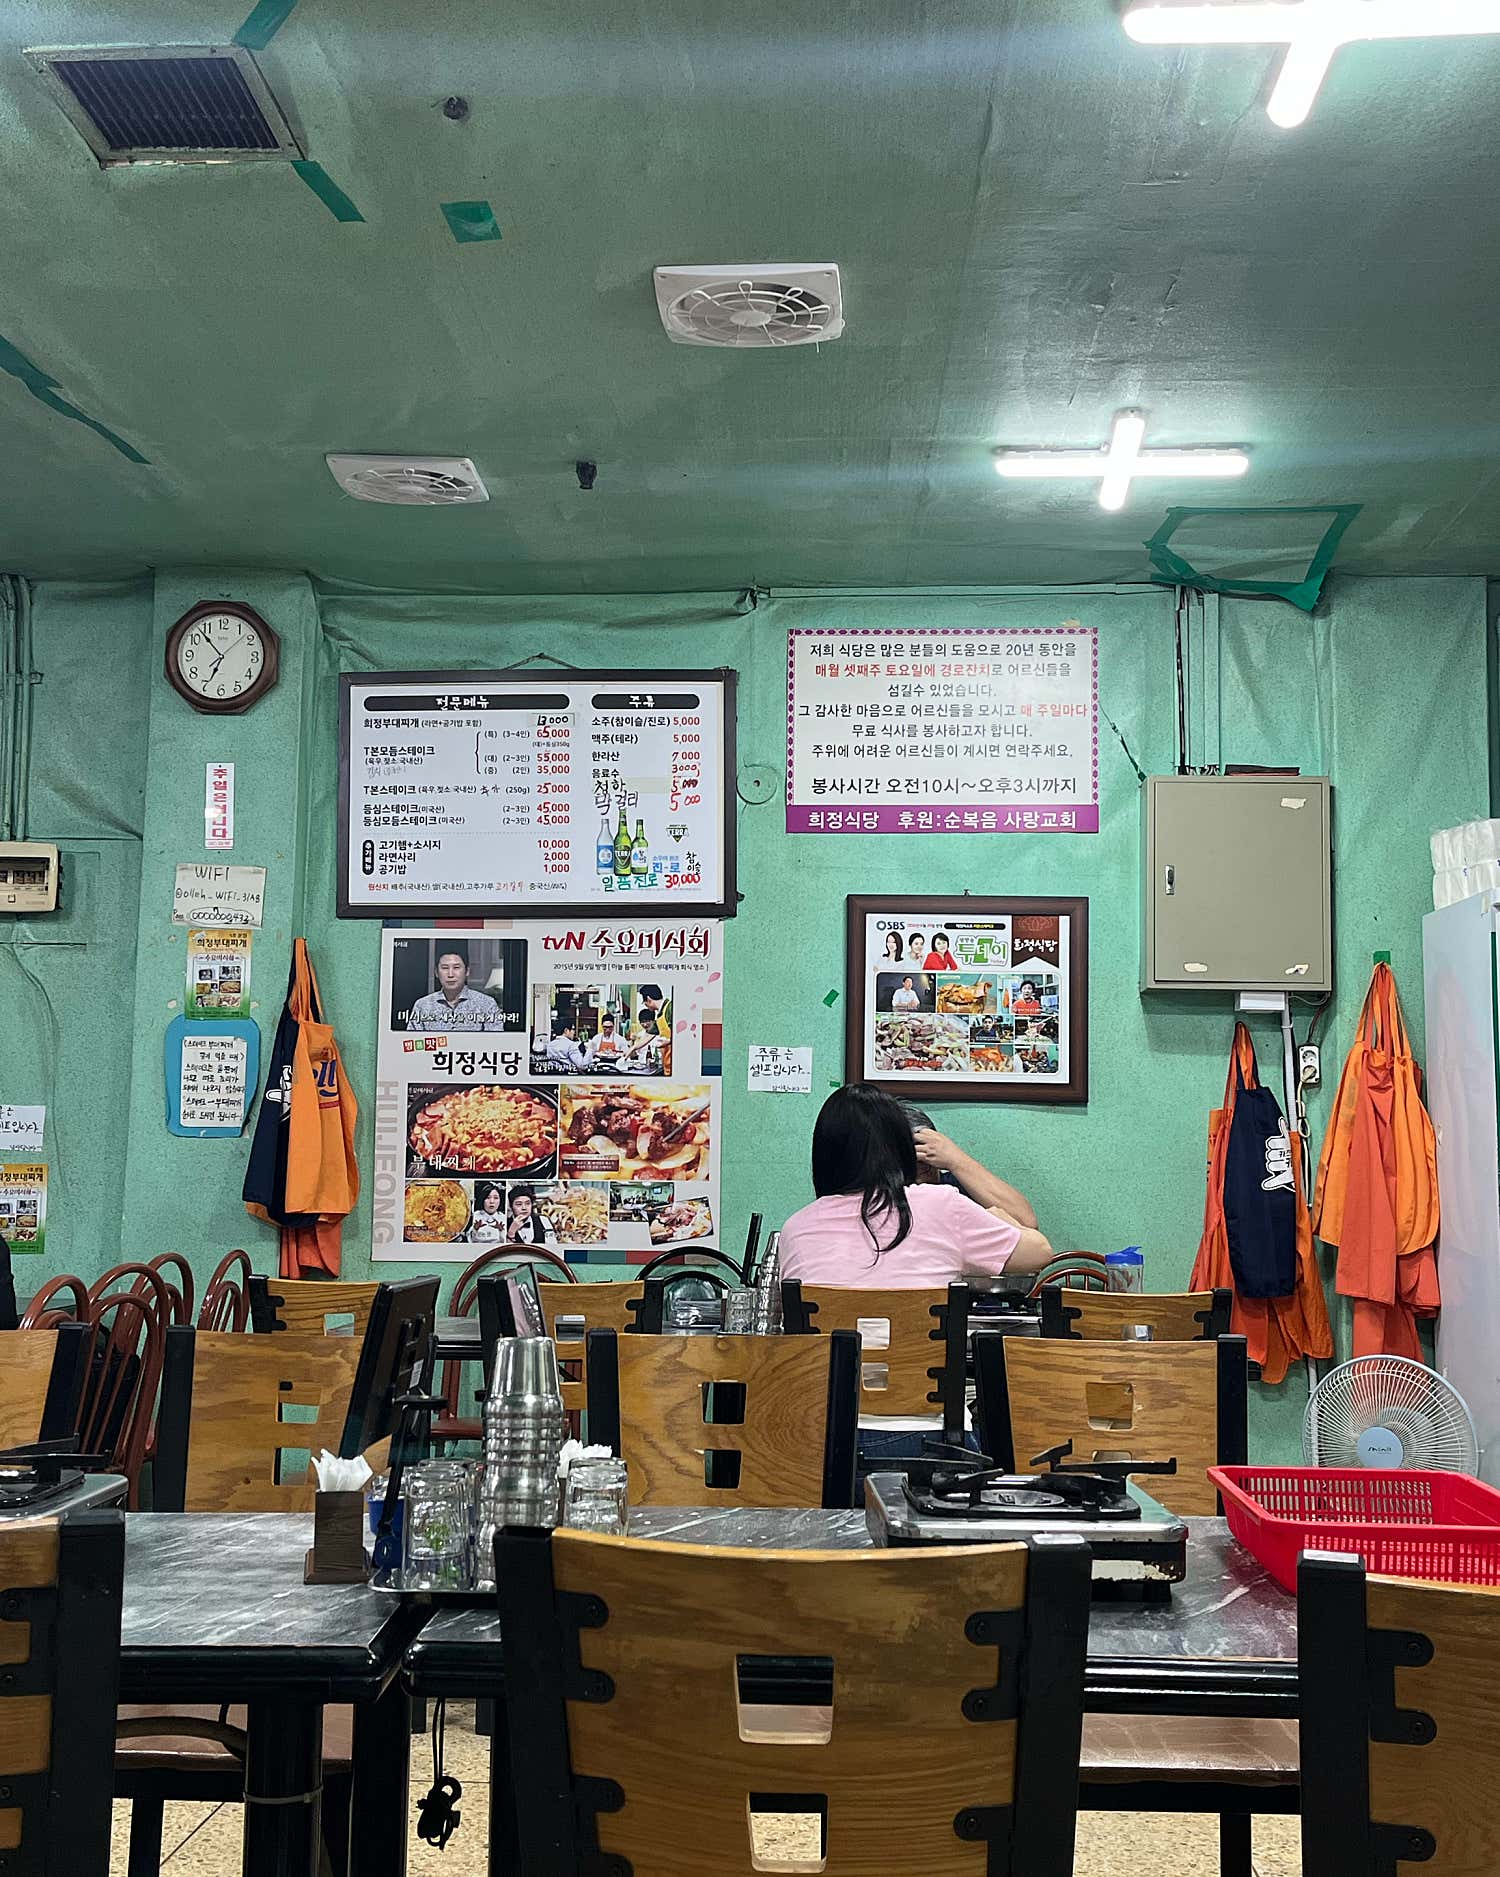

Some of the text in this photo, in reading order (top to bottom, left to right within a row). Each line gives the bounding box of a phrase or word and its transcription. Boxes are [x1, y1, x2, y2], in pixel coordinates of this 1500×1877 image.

[203, 622, 212, 634] 11
[219, 618, 229, 630] 12
[237, 623, 242, 635] 1
[190, 634, 201, 646] 10
[247, 634, 255, 646] 2
[185, 649, 194, 662] 9
[810, 642, 1077, 658] 저희 식당은 많은 분들의 도움으로 20년 동안을
[251, 651, 259, 664] 3
[189, 666, 198, 679] 8
[245, 667, 253, 680] 4
[815, 663, 1072, 678] 매월 셋째주 토요일에 경로잔치로 어르신들을
[202, 680, 211, 692] 7
[217, 684, 226, 697] 6
[233, 681, 242, 693] 5
[887, 683, 998, 698] 섬길수 있었습니다.
[435, 695, 490, 711] 전문메뉴
[629, 695, 656, 708] 주류
[799, 703, 1088, 718] 그 감사한 마음으로 어르신들을 모시고 매 주일마다
[363, 718, 420, 729] 희정부대찌개
[464, 719, 482, 728] 포함)
[591, 716, 700, 727] 소주(참이슬/진로) 5,000
[536, 725, 570, 739] 65,000
[852, 723, 1033, 739] 무료 식사를 봉사하고자 합니다.
[591, 733, 700, 745] 맥주(테라) 5,000
[363, 746, 436, 756] T본모듬스테이크
[591, 751, 621, 762] 한라산
[811, 743, 1074, 759] 주위에 어려운 어르신들이 계시면 연락주세요.
[399, 757, 423, 765] 국내산)
[484, 752, 570, 764] (대) (2~3인) 55,000
[512, 766, 530, 775] (2인)
[536, 765, 570, 776] 35,000
[591, 767, 620, 779] 음료수
[363, 785, 417, 796] T본스테이크
[453, 785, 477, 794] 국내산)
[505, 786, 530, 795] (250g)
[811, 776, 1077, 795] 봉사시간 오전10시~오후3시까지
[502, 805, 530, 814] (2~3인)
[536, 801, 570, 814] 45,000
[594, 790, 639, 815] 막걸리
[502, 817, 530, 826] (2~3인)
[536, 814, 570, 826] 45,000
[808, 811, 880, 830] 희정식당
[1003, 810, 1077, 829] 사랑교회
[378, 839, 570, 851] 고기햄+소시지 10,000
[378, 851, 570, 863] 라면사리 2,000
[194, 865, 230, 881] WIFI
[378, 863, 570, 876] 공기밥 1,000
[664, 872, 701, 889] 30,000
[887, 920, 905, 930] SBS
[542, 925, 711, 958] tvN 수요미식회
[1013, 937, 1058, 953] 희정식당
[956, 937, 1007, 964] 투데이
[431, 1051, 522, 1076] 희정식당
